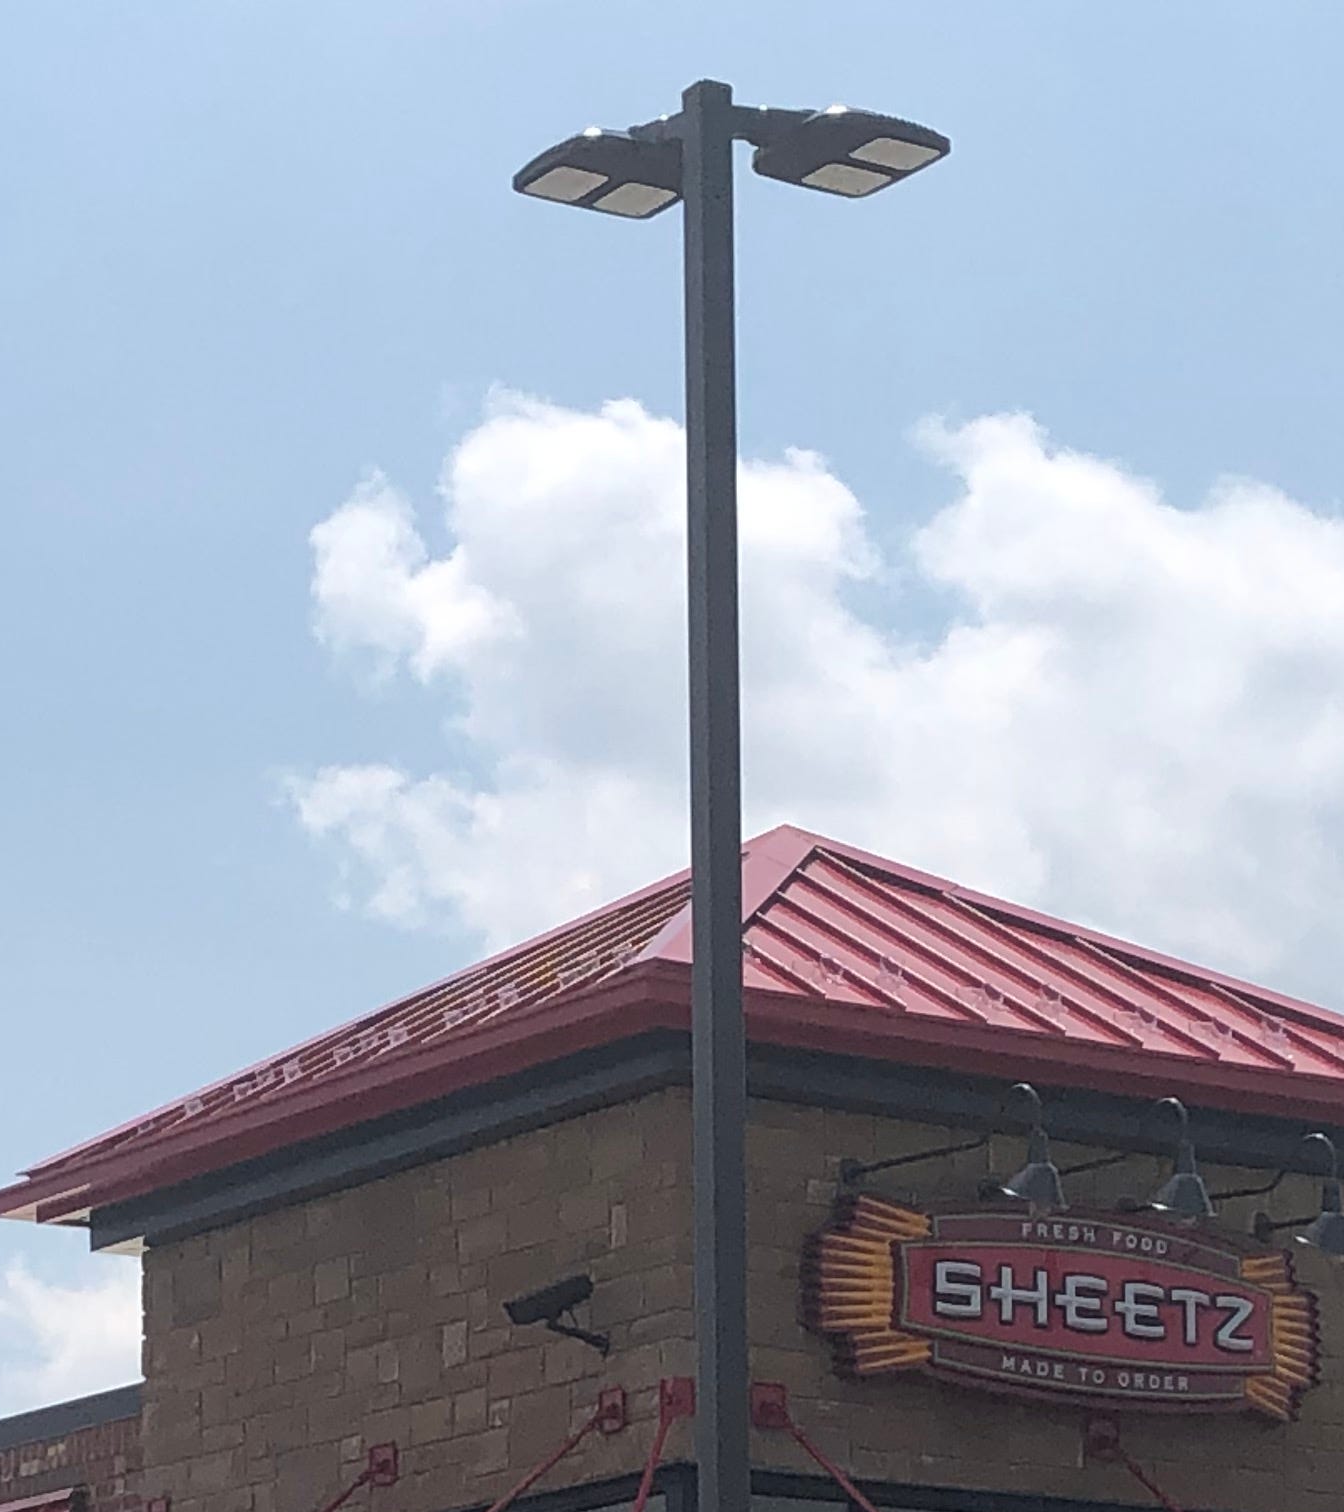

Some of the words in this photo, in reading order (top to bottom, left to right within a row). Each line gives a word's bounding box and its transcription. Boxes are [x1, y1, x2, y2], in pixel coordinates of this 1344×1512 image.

[1021, 1222, 1096, 1243] FRESH
[1112, 1231, 1168, 1254] FOOD
[935, 1260, 1254, 1350] SHEETZ
[1001, 1355, 1064, 1379] MADE
[1078, 1367, 1105, 1384] TO
[1117, 1372, 1188, 1391] ORDER
